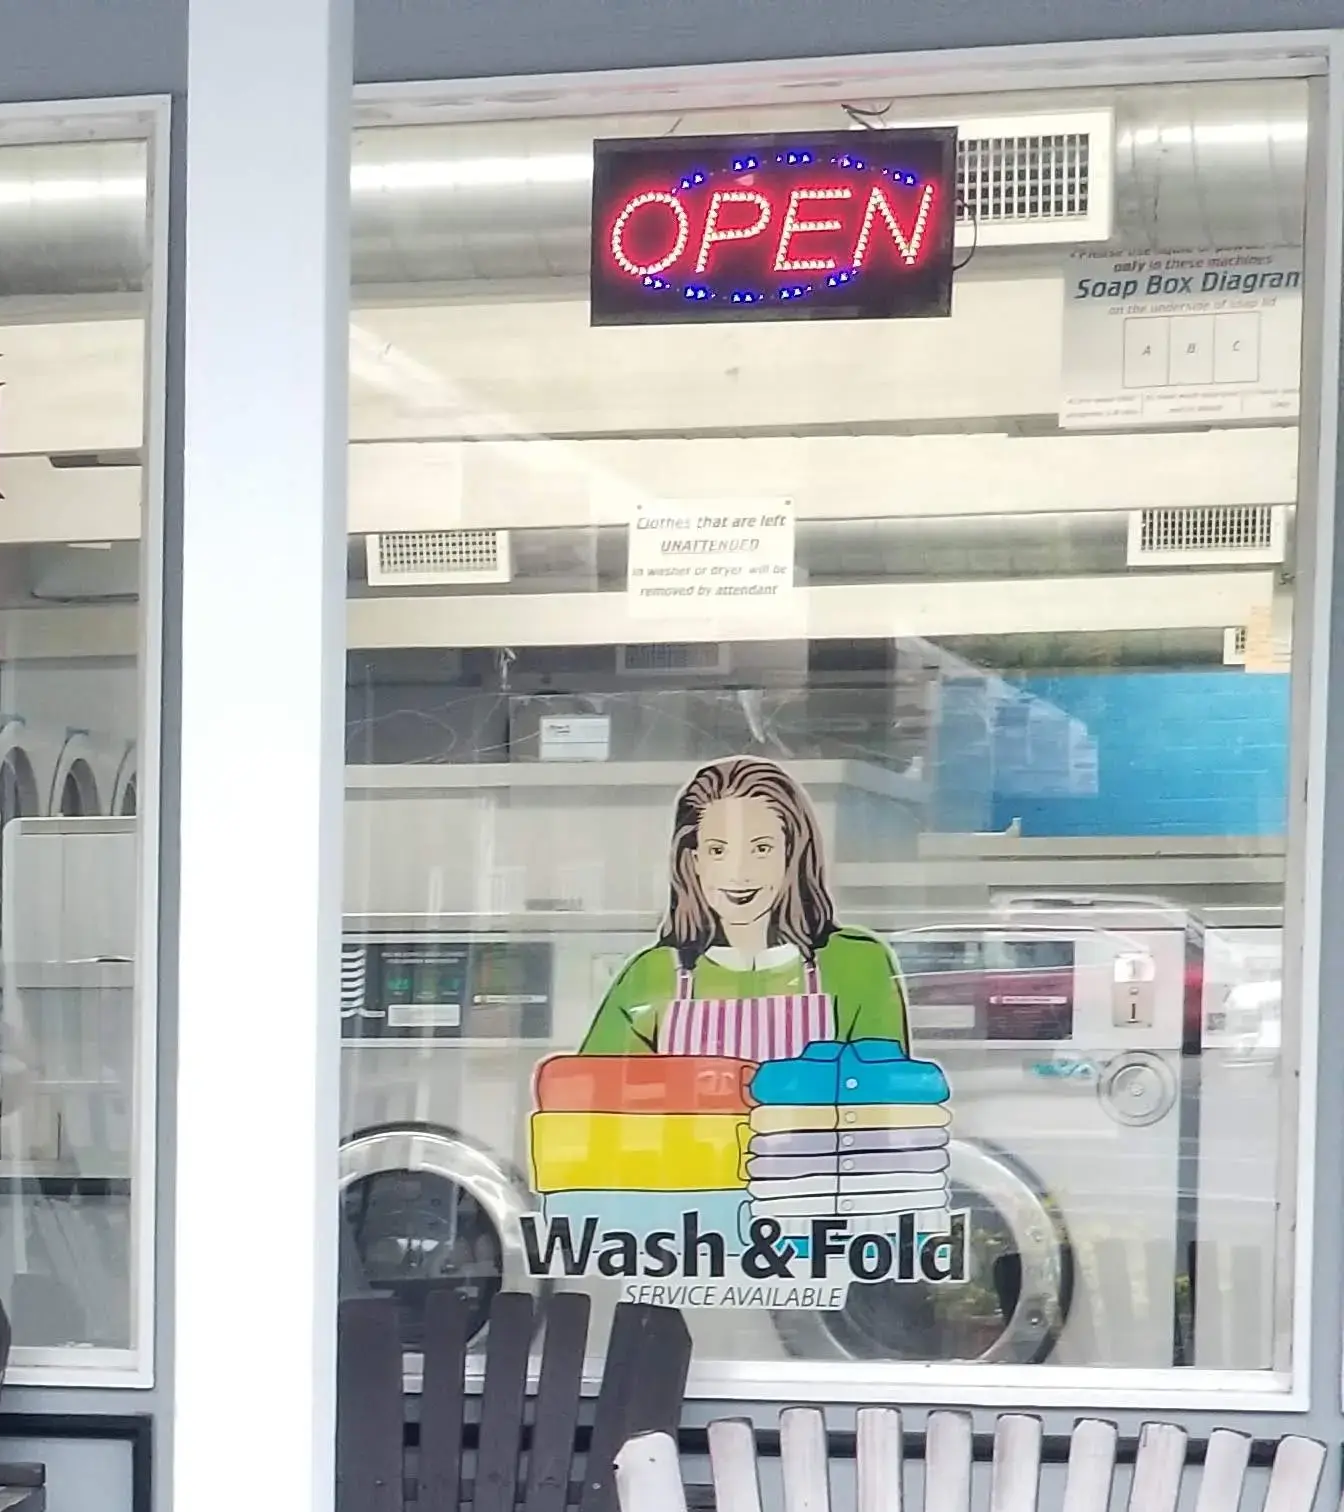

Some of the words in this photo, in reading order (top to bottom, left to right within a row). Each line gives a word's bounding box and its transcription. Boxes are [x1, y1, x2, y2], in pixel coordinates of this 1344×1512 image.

[609, 184, 936, 277] OPEN
[1074, 278, 1138, 299] Soap
[1146, 274, 1193, 295] Box
[1141, 345, 1152, 356] A
[1232, 340, 1241, 352] C
[636, 516, 690, 530] Clothes
[696, 516, 727, 529] that
[732, 517, 756, 528] are
[760, 515, 786, 527] left
[661, 538, 760, 554] UNATTENDED
[640, 585, 695, 597] removed
[697, 585, 712, 597] by
[715, 584, 778, 596] attendant
[518, 1211, 725, 1279] Wash
[811, 1213, 966, 1281] Fold
[625, 1284, 717, 1307] SERVICE
[721, 1286, 842, 1308] AVAILABLE
